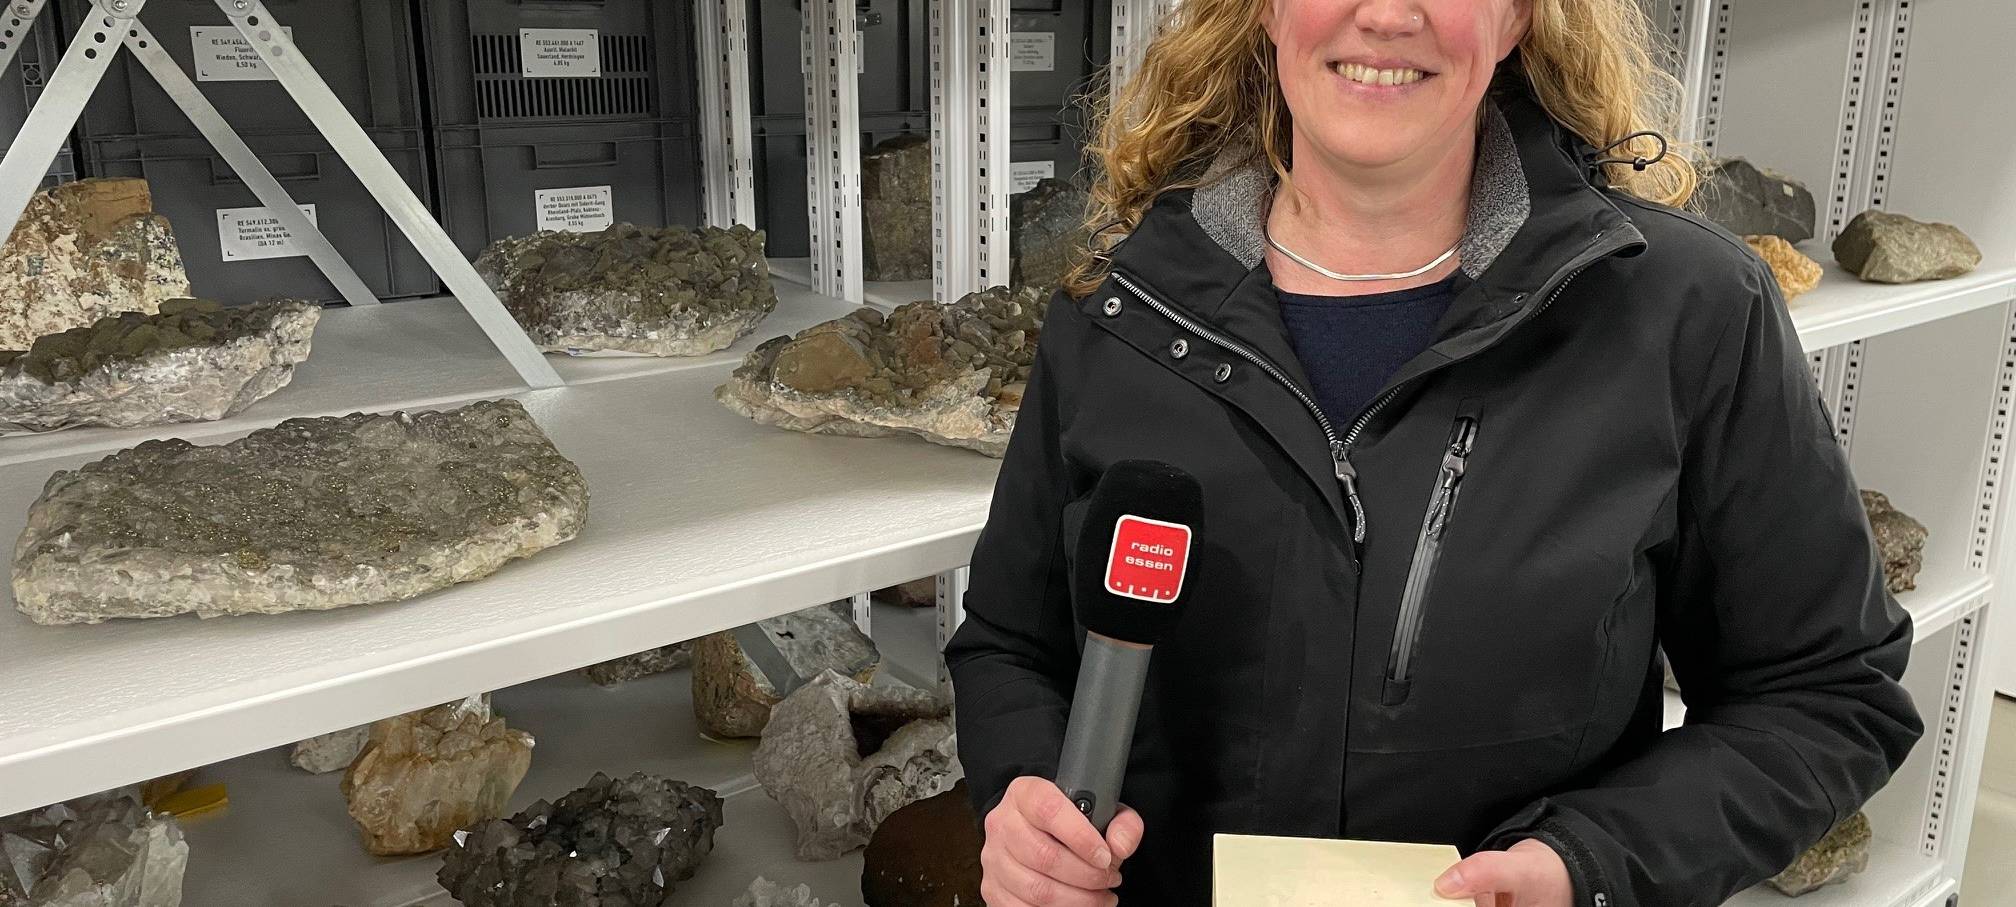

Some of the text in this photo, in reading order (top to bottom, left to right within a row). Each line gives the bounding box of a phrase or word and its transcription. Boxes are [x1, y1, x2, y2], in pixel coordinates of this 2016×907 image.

[249, 61, 257, 69] kg
[1131, 541, 1174, 557] radio
[1125, 555, 1173, 572] essen
